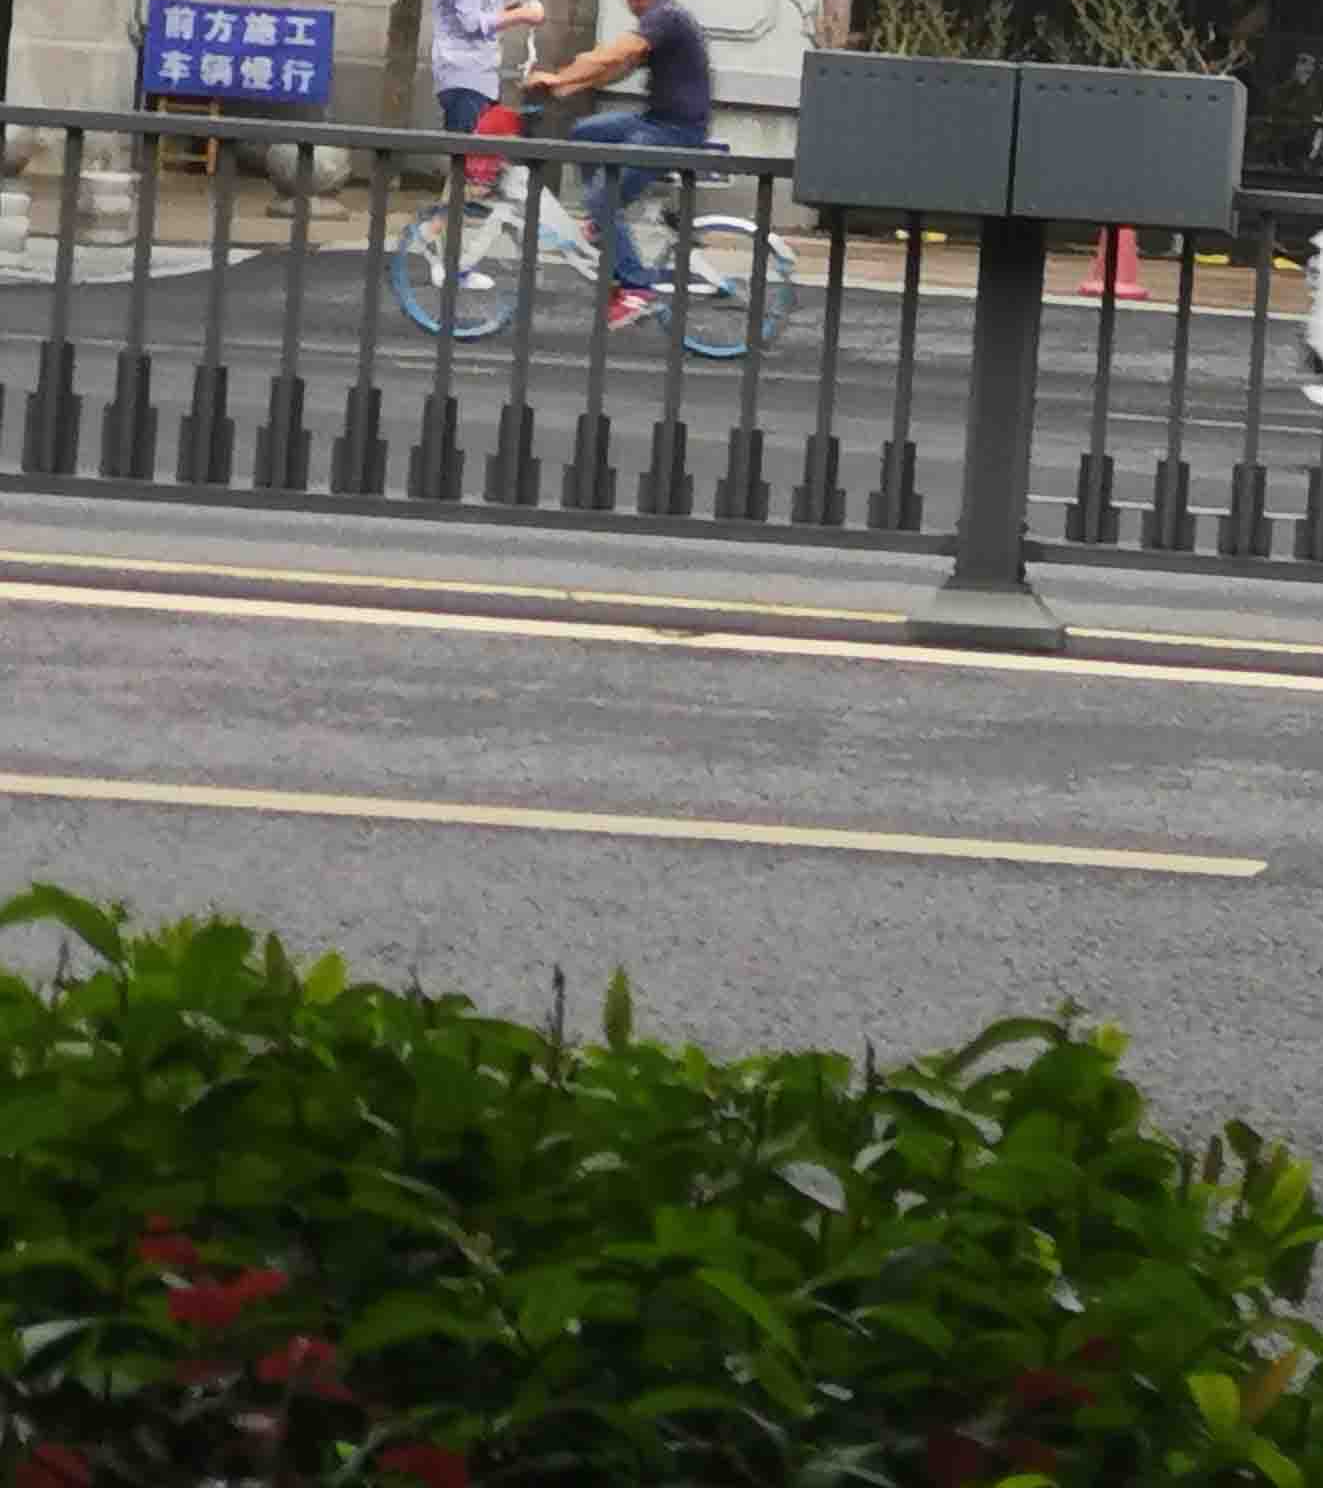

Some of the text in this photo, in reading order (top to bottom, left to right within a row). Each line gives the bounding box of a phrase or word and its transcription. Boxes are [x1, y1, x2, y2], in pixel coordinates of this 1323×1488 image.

[163, 4, 317, 46] 前方施工
[158, 50, 316, 94] 车辆慢行
